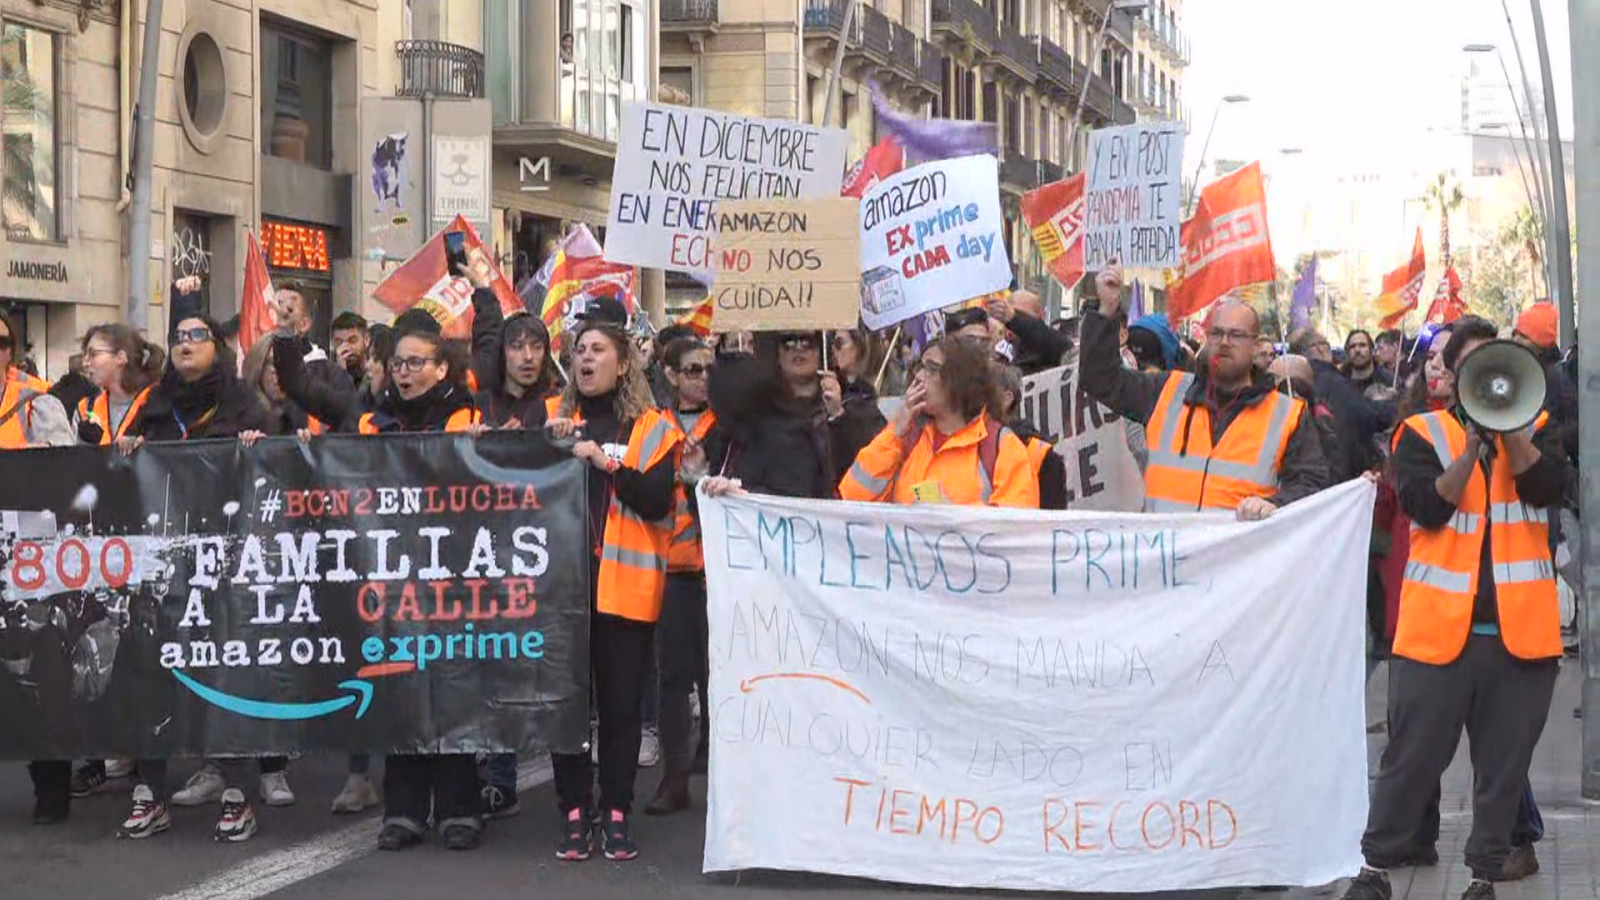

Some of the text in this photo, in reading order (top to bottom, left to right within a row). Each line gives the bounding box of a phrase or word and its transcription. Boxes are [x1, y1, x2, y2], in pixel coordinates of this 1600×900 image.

[642, 109, 688, 156] EN
[1109, 135, 1130, 180] EN
[1137, 130, 1177, 177] POST
[519, 156, 550, 182] M
[650, 160, 692, 195] NOS
[617, 193, 651, 225] EN
[719, 211, 807, 233] AMAZON
[864, 170, 947, 231] amazon
[1149, 182, 1169, 220] TE
[722, 248, 822, 273] NO NOS
[902, 232, 995, 280] CADA day
[1130, 225, 1176, 264] PATADA
[7, 260, 68, 284] JAMONERÍA
[12, 537, 133, 591] 800
[188, 526, 550, 586] FAMILIAS
[722, 504, 1012, 596] EMPLEADOS
[179, 578, 538, 627] A LA CALLE
[160, 624, 544, 670] amazon exprime
[729, 600, 1235, 690] AMAZON NOS MANDA A
[1124, 738, 1173, 791] EN
[1044, 798, 1237, 853] RECORD
